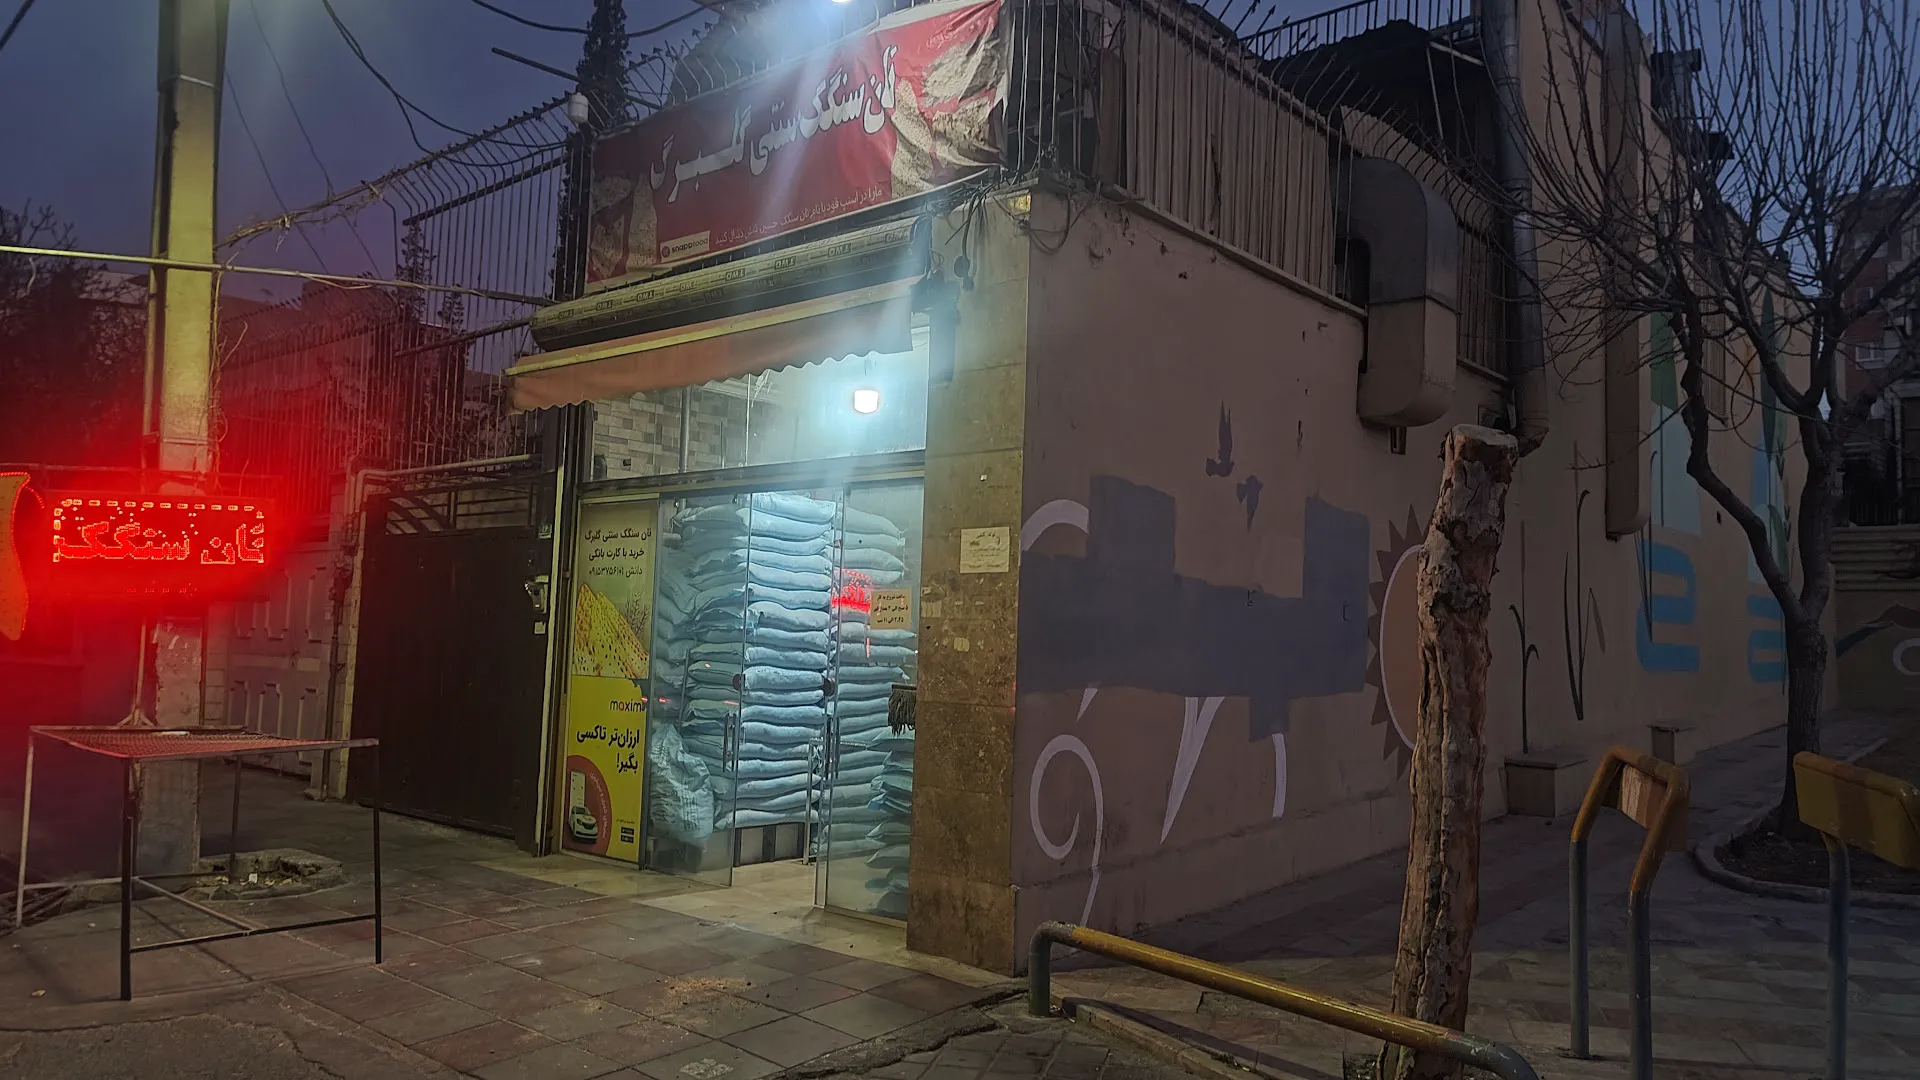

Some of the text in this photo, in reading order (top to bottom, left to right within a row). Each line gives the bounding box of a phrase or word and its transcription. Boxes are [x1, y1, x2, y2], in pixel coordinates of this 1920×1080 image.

[649, 44, 898, 203] نان سنگک سنتی گلبرگ
[826, 197, 839, 211] فود
[58, 520, 265, 565] نان سنگک
[584, 527, 652, 543] نان سنگک سنتی گلبرگ
[588, 547, 645, 561] خرید با کارت بانکی
[625, 565, 643, 578] دانش
[610, 699, 642, 712] maxim
[576, 724, 606, 743] تاکسی
[616, 752, 638, 774] بگیر!
